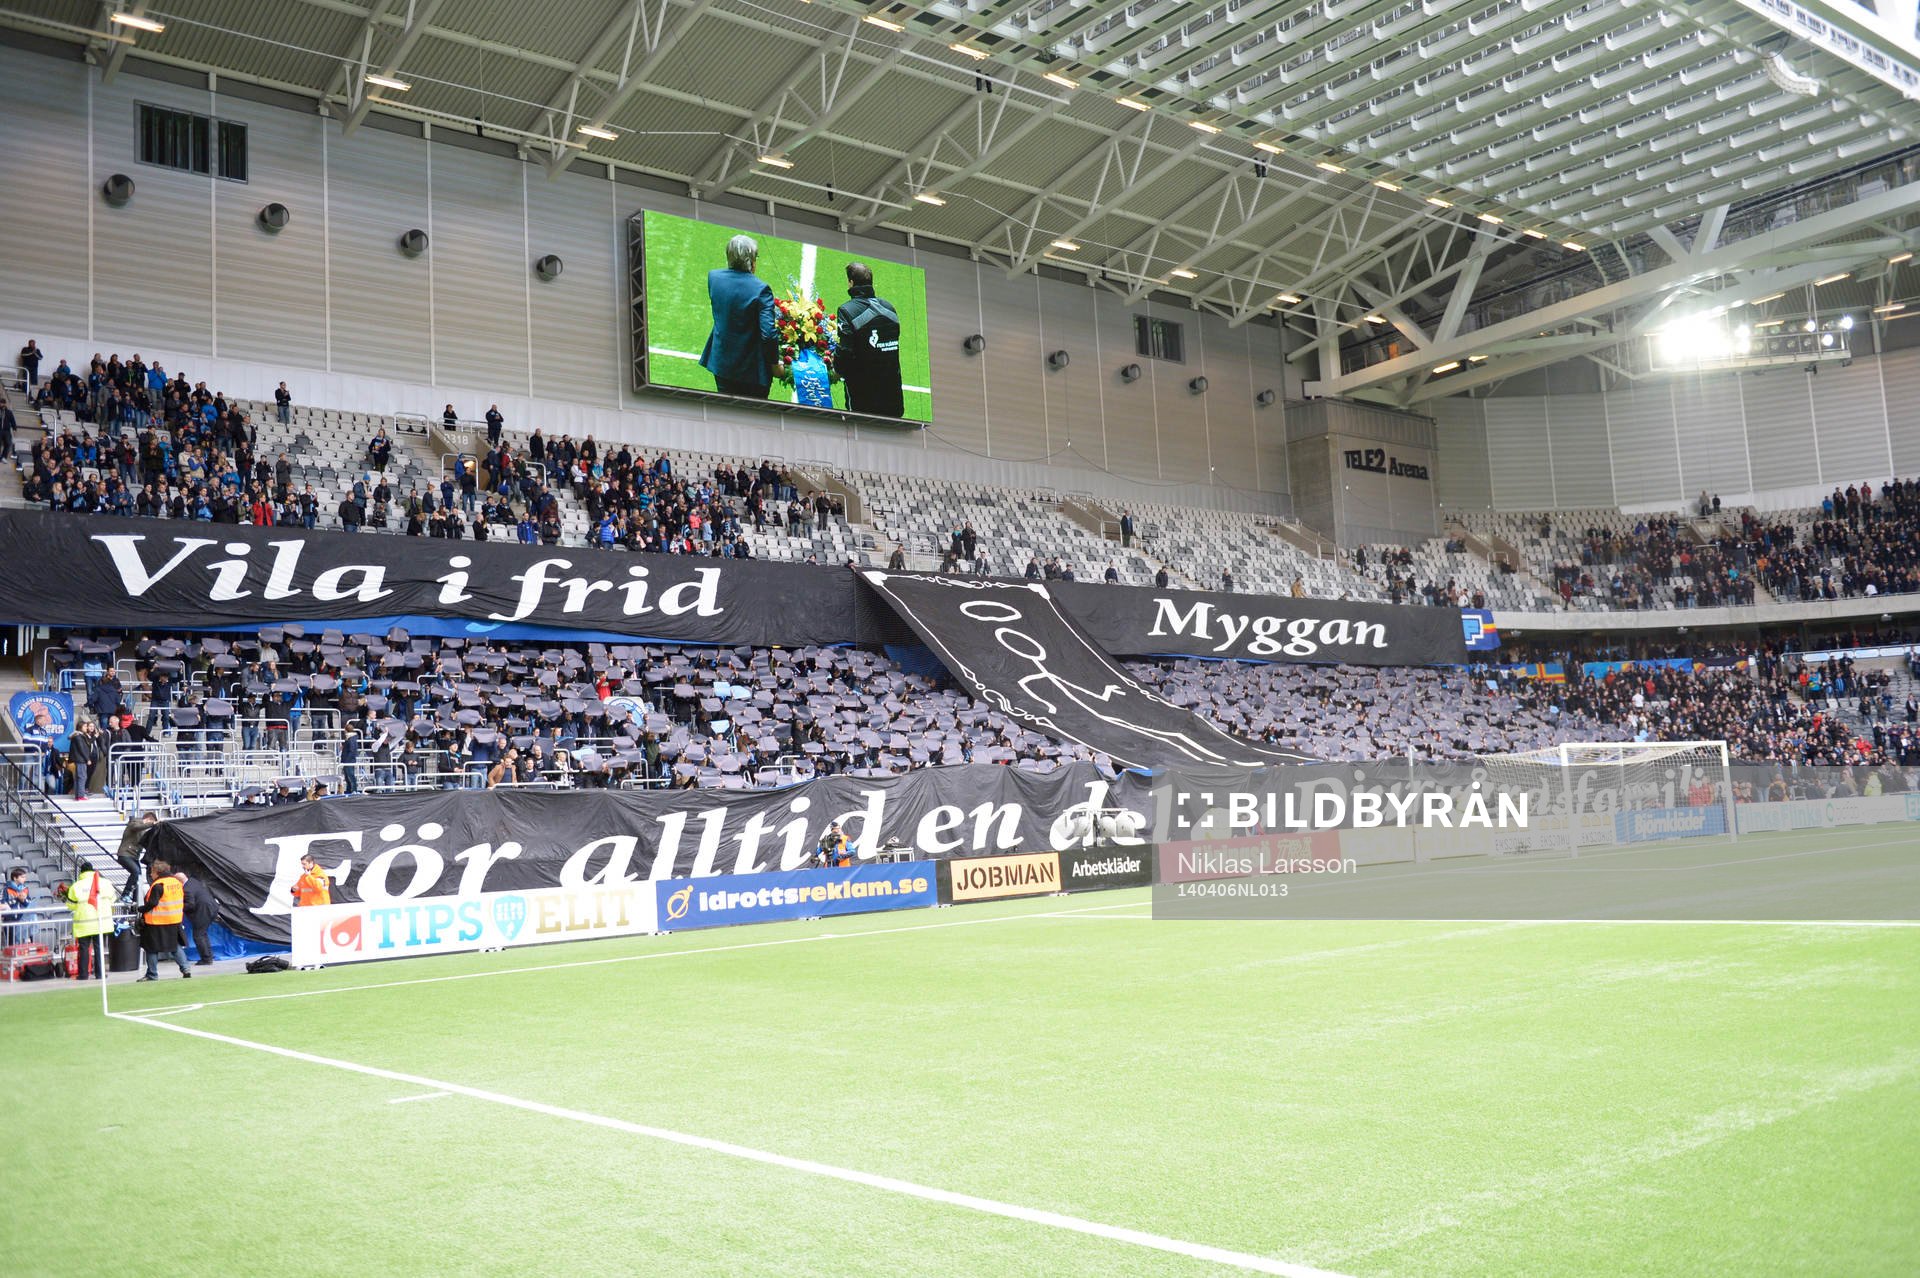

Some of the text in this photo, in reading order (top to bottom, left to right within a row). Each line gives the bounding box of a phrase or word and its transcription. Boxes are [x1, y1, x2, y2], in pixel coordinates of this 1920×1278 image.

[1344, 449, 1430, 480] TELE2 Arena
[91, 534, 724, 622] Vila i frid
[1148, 598, 1388, 656] Myggan
[249, 822, 523, 916] För
[558, 790, 888, 880] alltid
[917, 798, 1025, 854] en
[957, 862, 1054, 891] JOBMAN
[1072, 857, 1141, 878] Arbetskläder
[370, 890, 635, 949] TIPS ELIT
